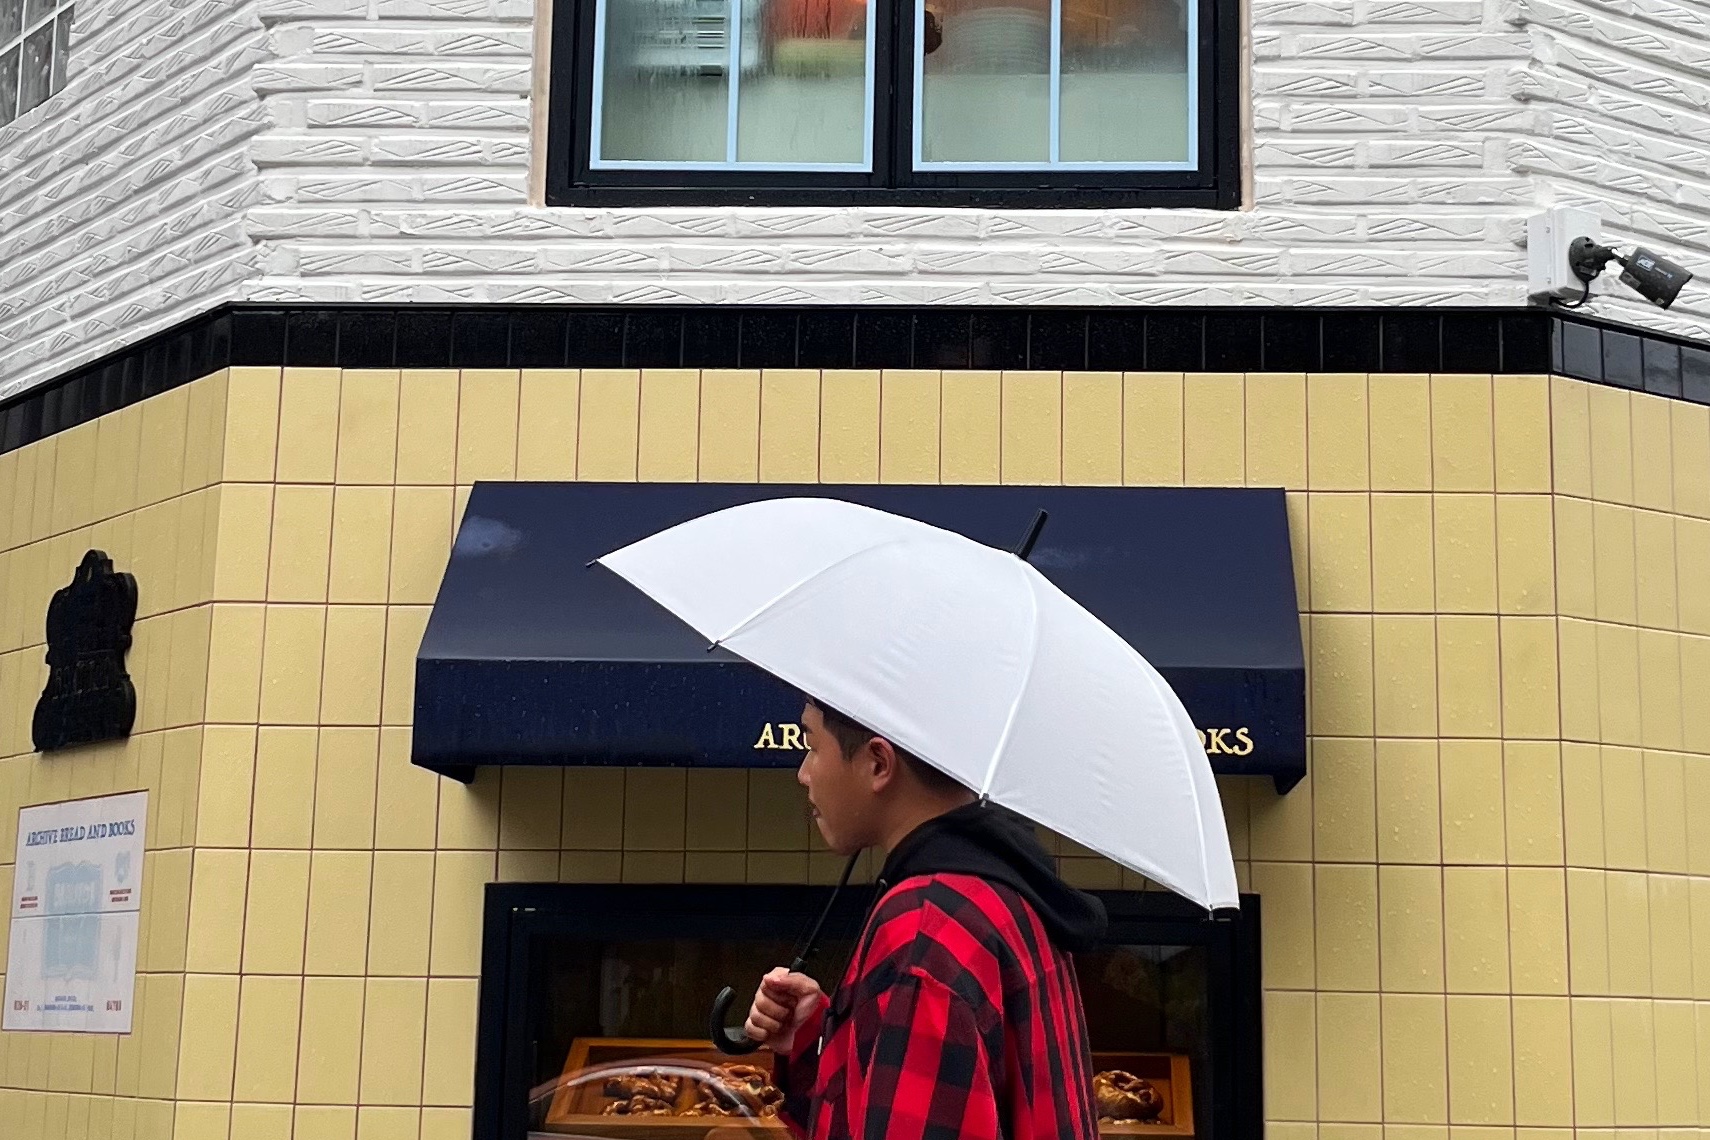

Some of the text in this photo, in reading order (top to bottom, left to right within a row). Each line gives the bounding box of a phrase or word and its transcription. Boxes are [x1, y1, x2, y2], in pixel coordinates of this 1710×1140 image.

[27, 820, 135, 846] ARCHIVE BREAD AND BOOKS
